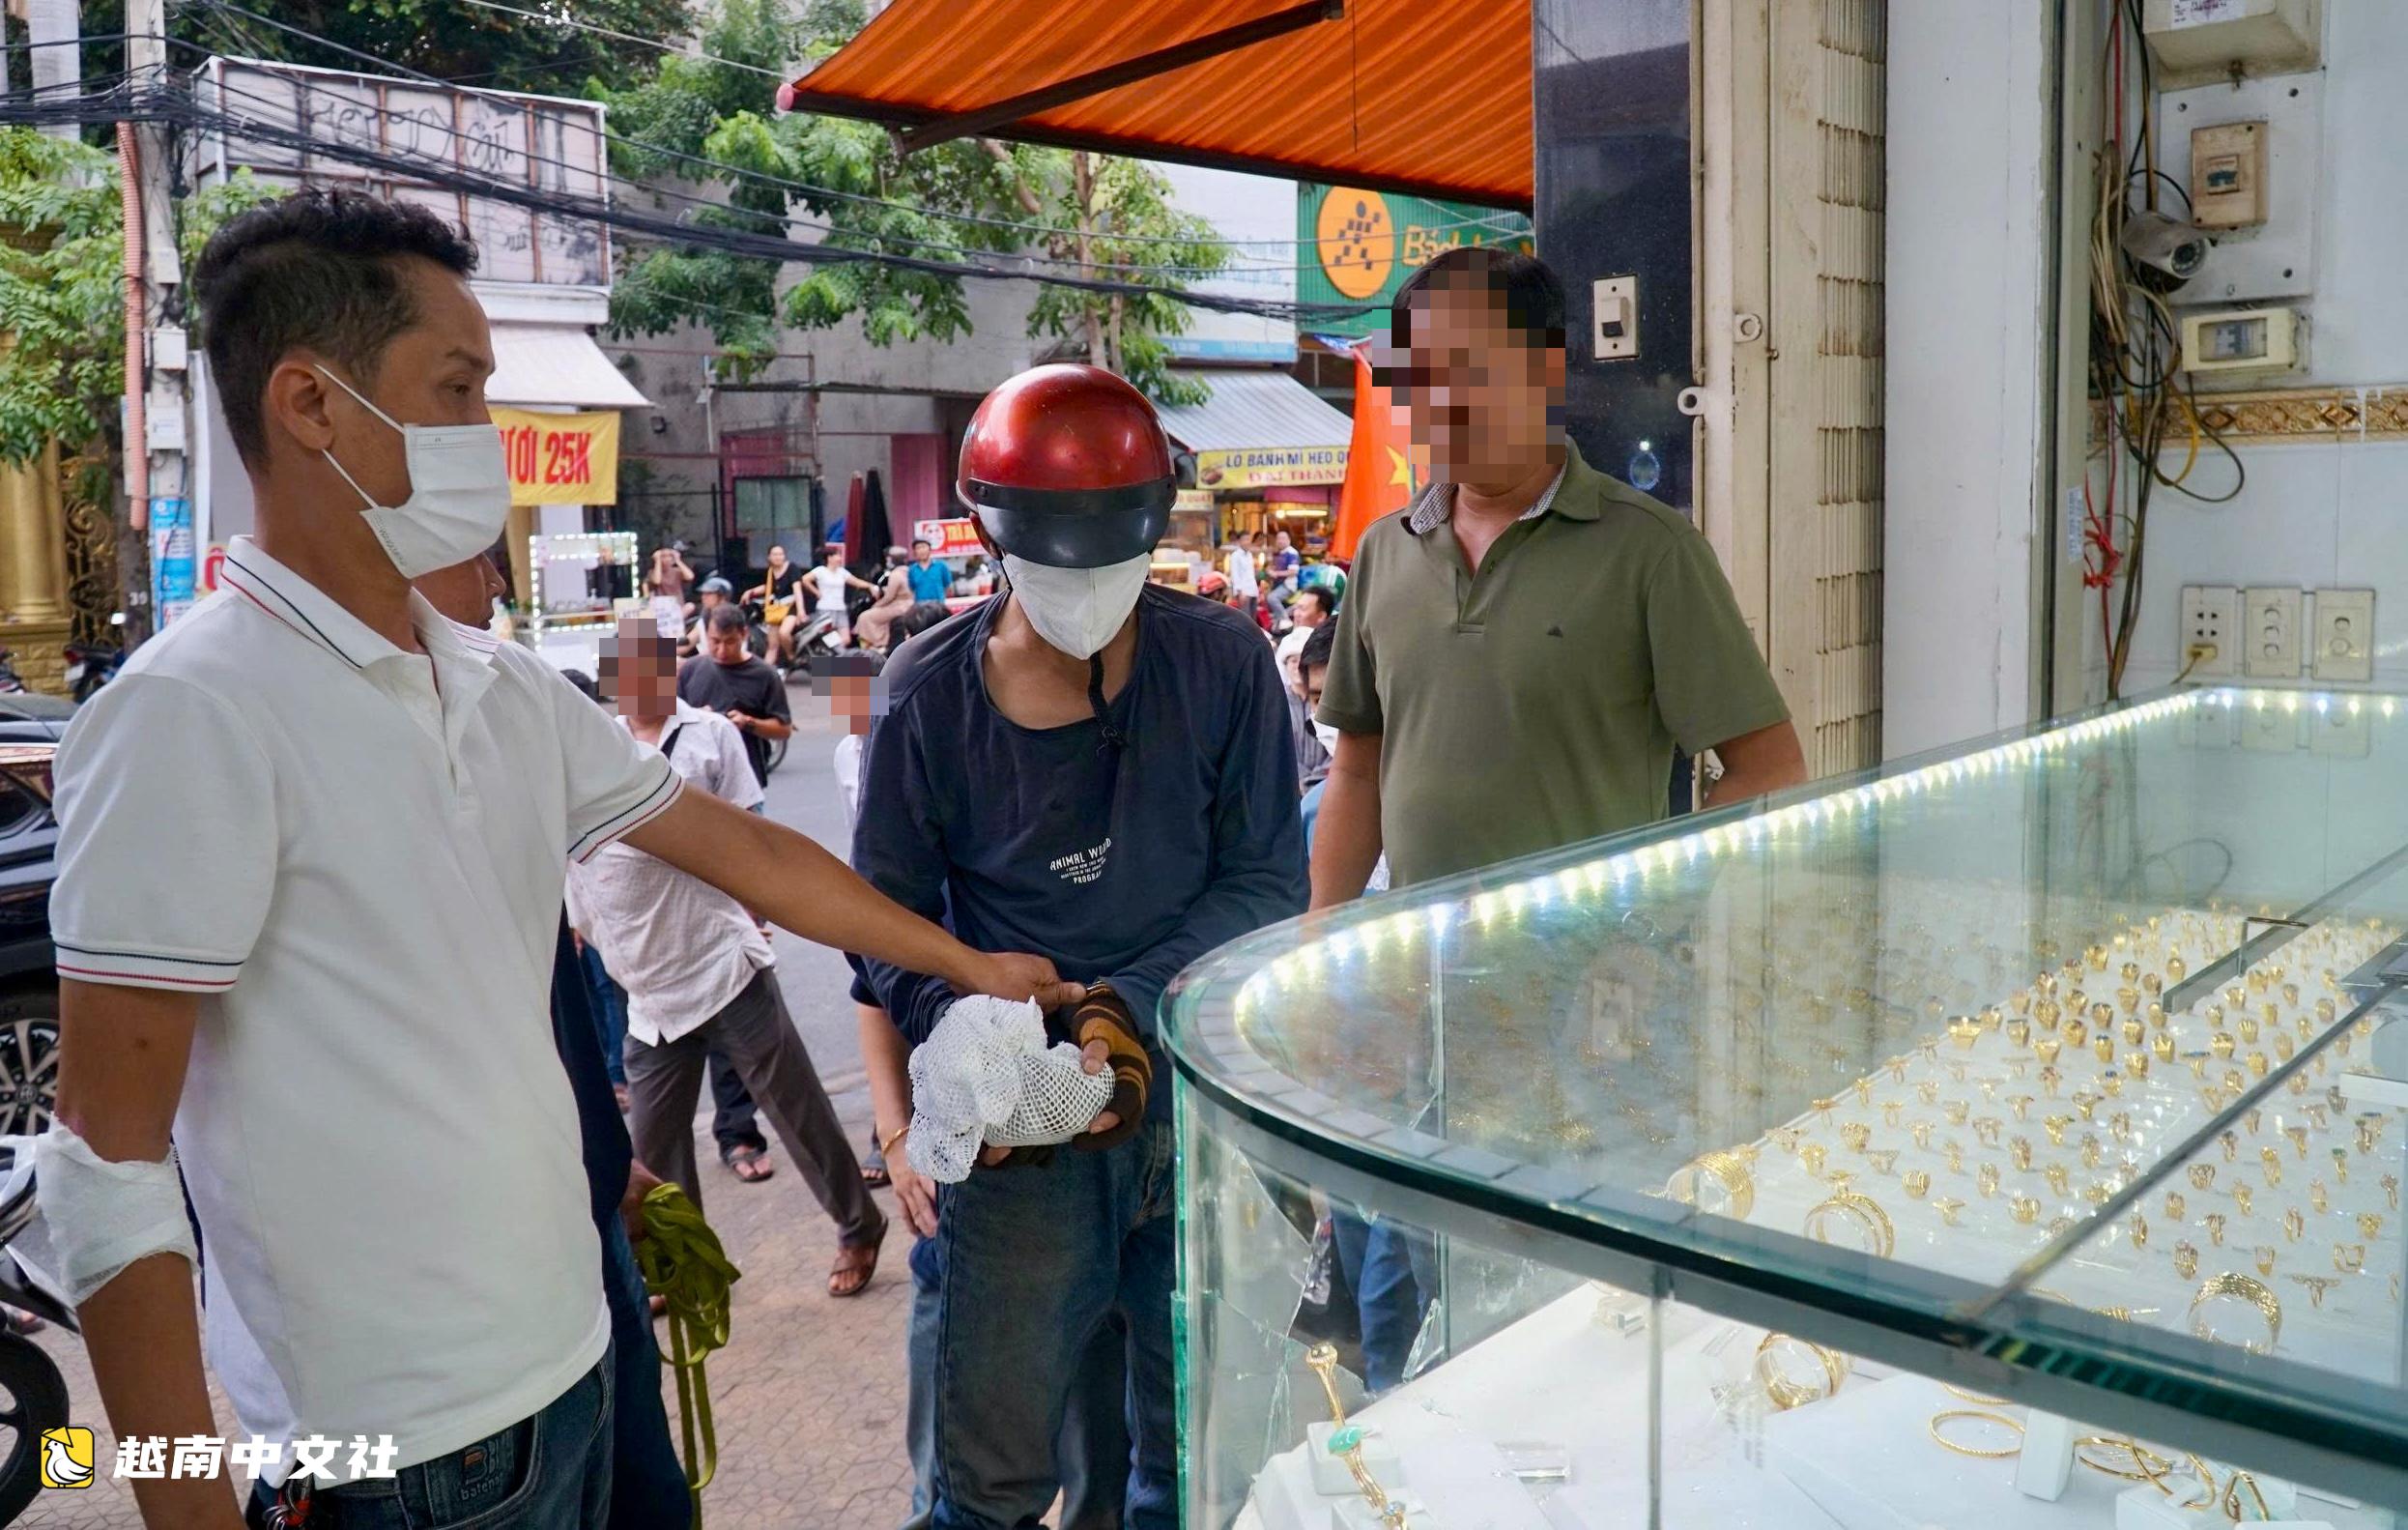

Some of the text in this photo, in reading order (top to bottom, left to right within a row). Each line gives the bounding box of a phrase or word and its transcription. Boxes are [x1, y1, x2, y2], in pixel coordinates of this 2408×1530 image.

[544, 430, 591, 484] 25K
[1308, 450, 1333, 464] HEO
[1049, 852, 1085, 871] ANIMAL
